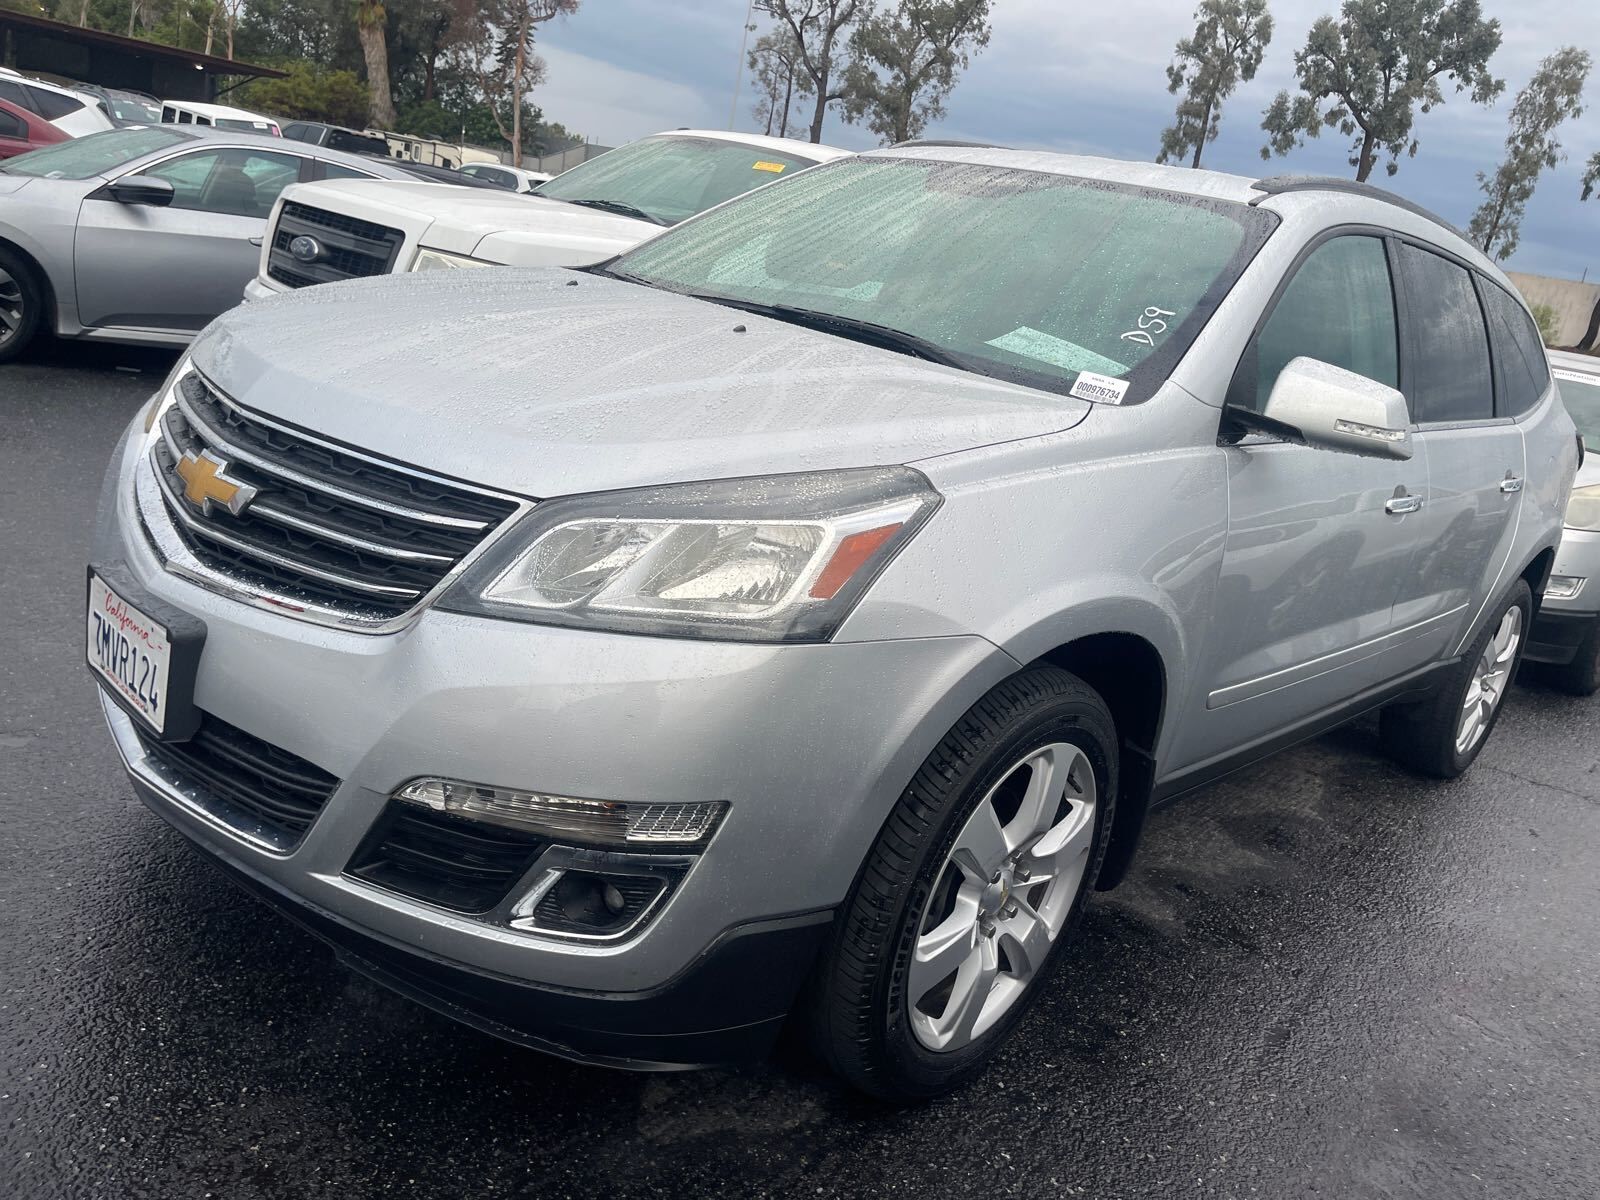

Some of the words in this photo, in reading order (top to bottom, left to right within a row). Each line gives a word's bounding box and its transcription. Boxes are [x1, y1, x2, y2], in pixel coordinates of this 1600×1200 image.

[1077, 381, 1121, 400] 000976734
[105, 592, 154, 649] California
[94, 611, 158, 712] 7MVR124
